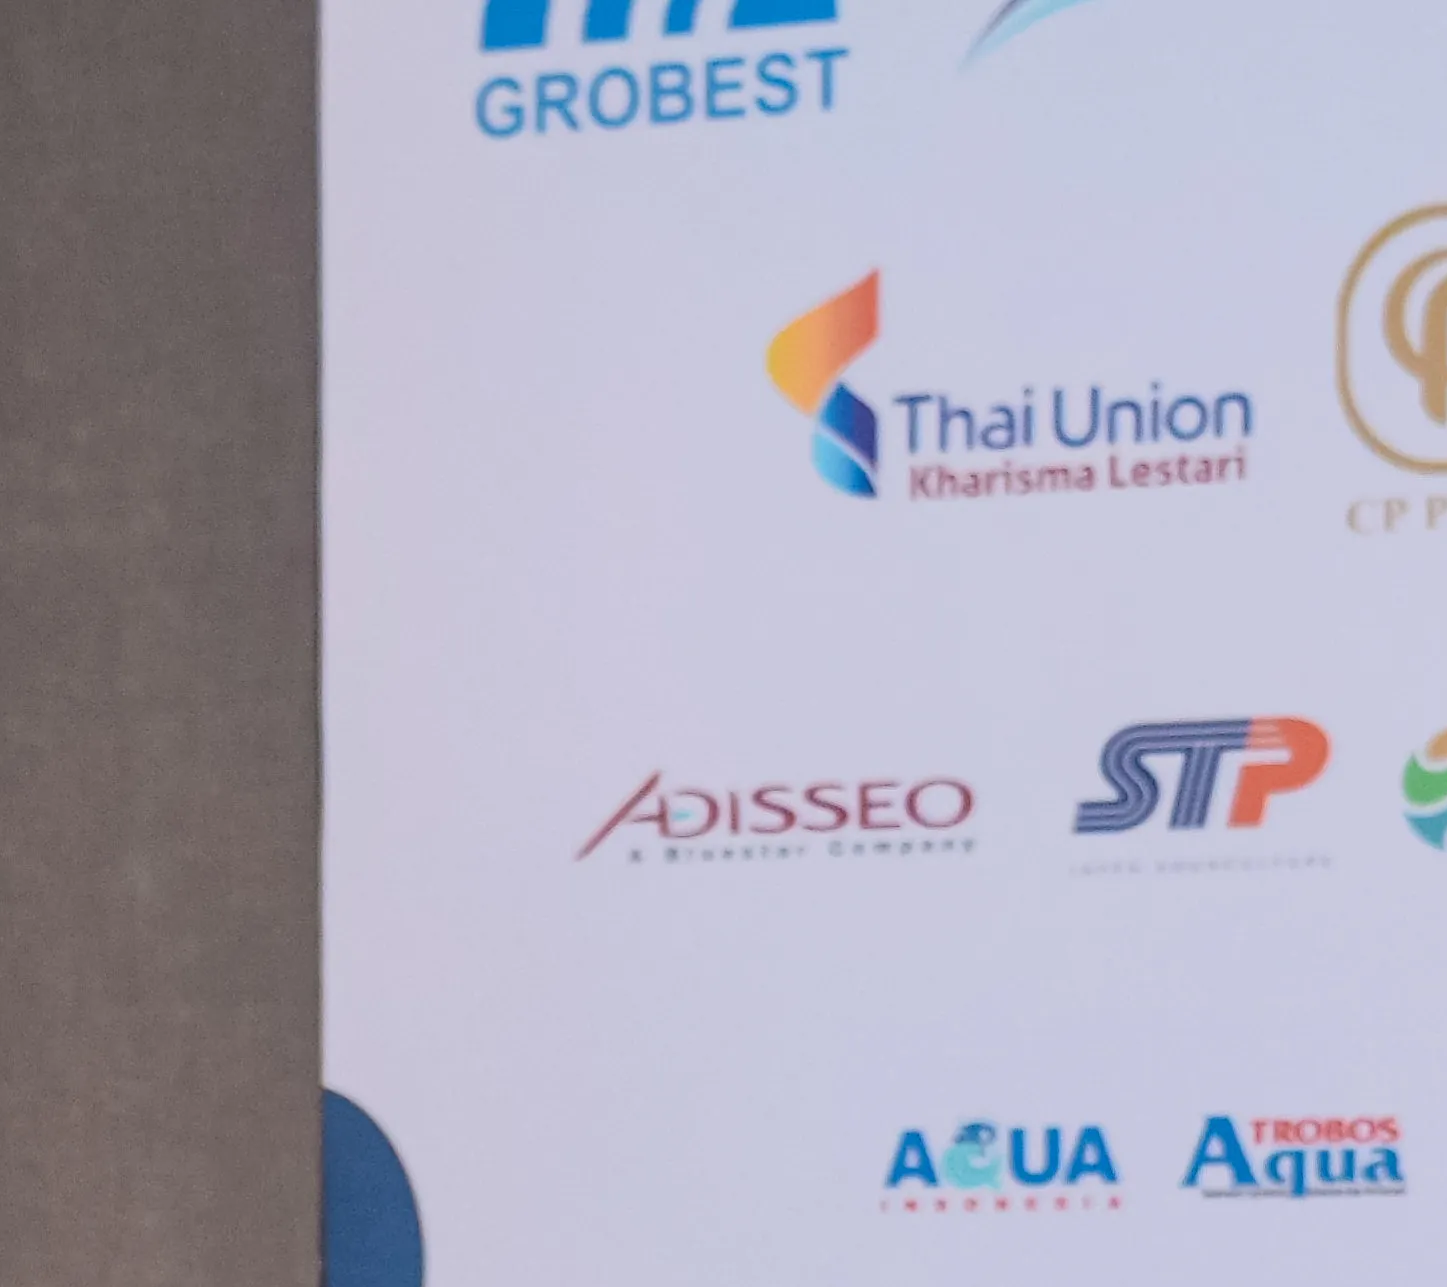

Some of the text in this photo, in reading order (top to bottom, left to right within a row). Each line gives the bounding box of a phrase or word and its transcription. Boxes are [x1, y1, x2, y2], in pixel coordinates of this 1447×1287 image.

[475, 47, 850, 139] GROBEST
[893, 382, 1253, 454] Thai Union
[909, 445, 1248, 500] Kharisma Lestari
[575, 770, 976, 861] ADISSEO
[1073, 717, 1330, 834] STP
[1183, 1115, 1404, 1197] Aqua
[1251, 1116, 1401, 1144] TROBOS
